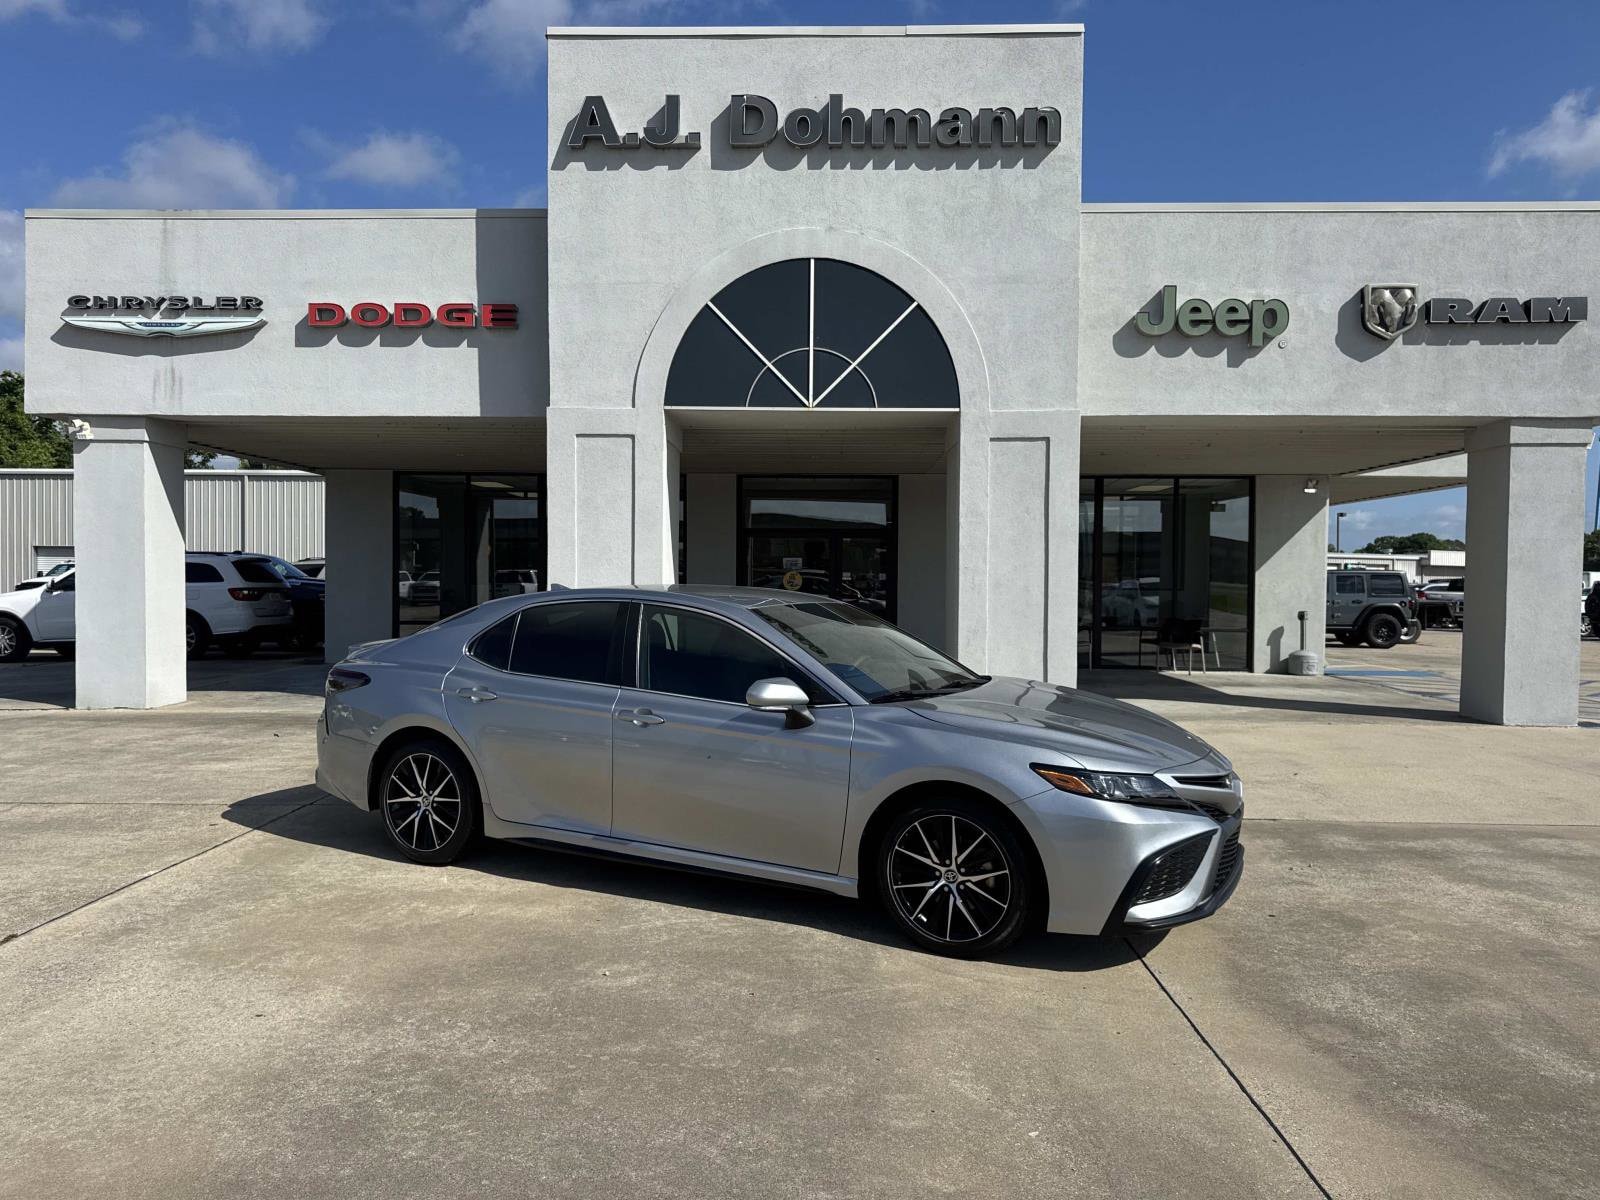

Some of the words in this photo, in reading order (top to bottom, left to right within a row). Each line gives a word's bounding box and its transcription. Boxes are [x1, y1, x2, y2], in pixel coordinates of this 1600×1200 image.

[567, 95, 701, 147] A.J.
[730, 94, 1062, 147] Dohmann
[67, 295, 264, 310] CHRYSLER
[308, 303, 518, 328] DODGE
[1427, 297, 1588, 323] RAM
[1135, 285, 1290, 347] Jeep
